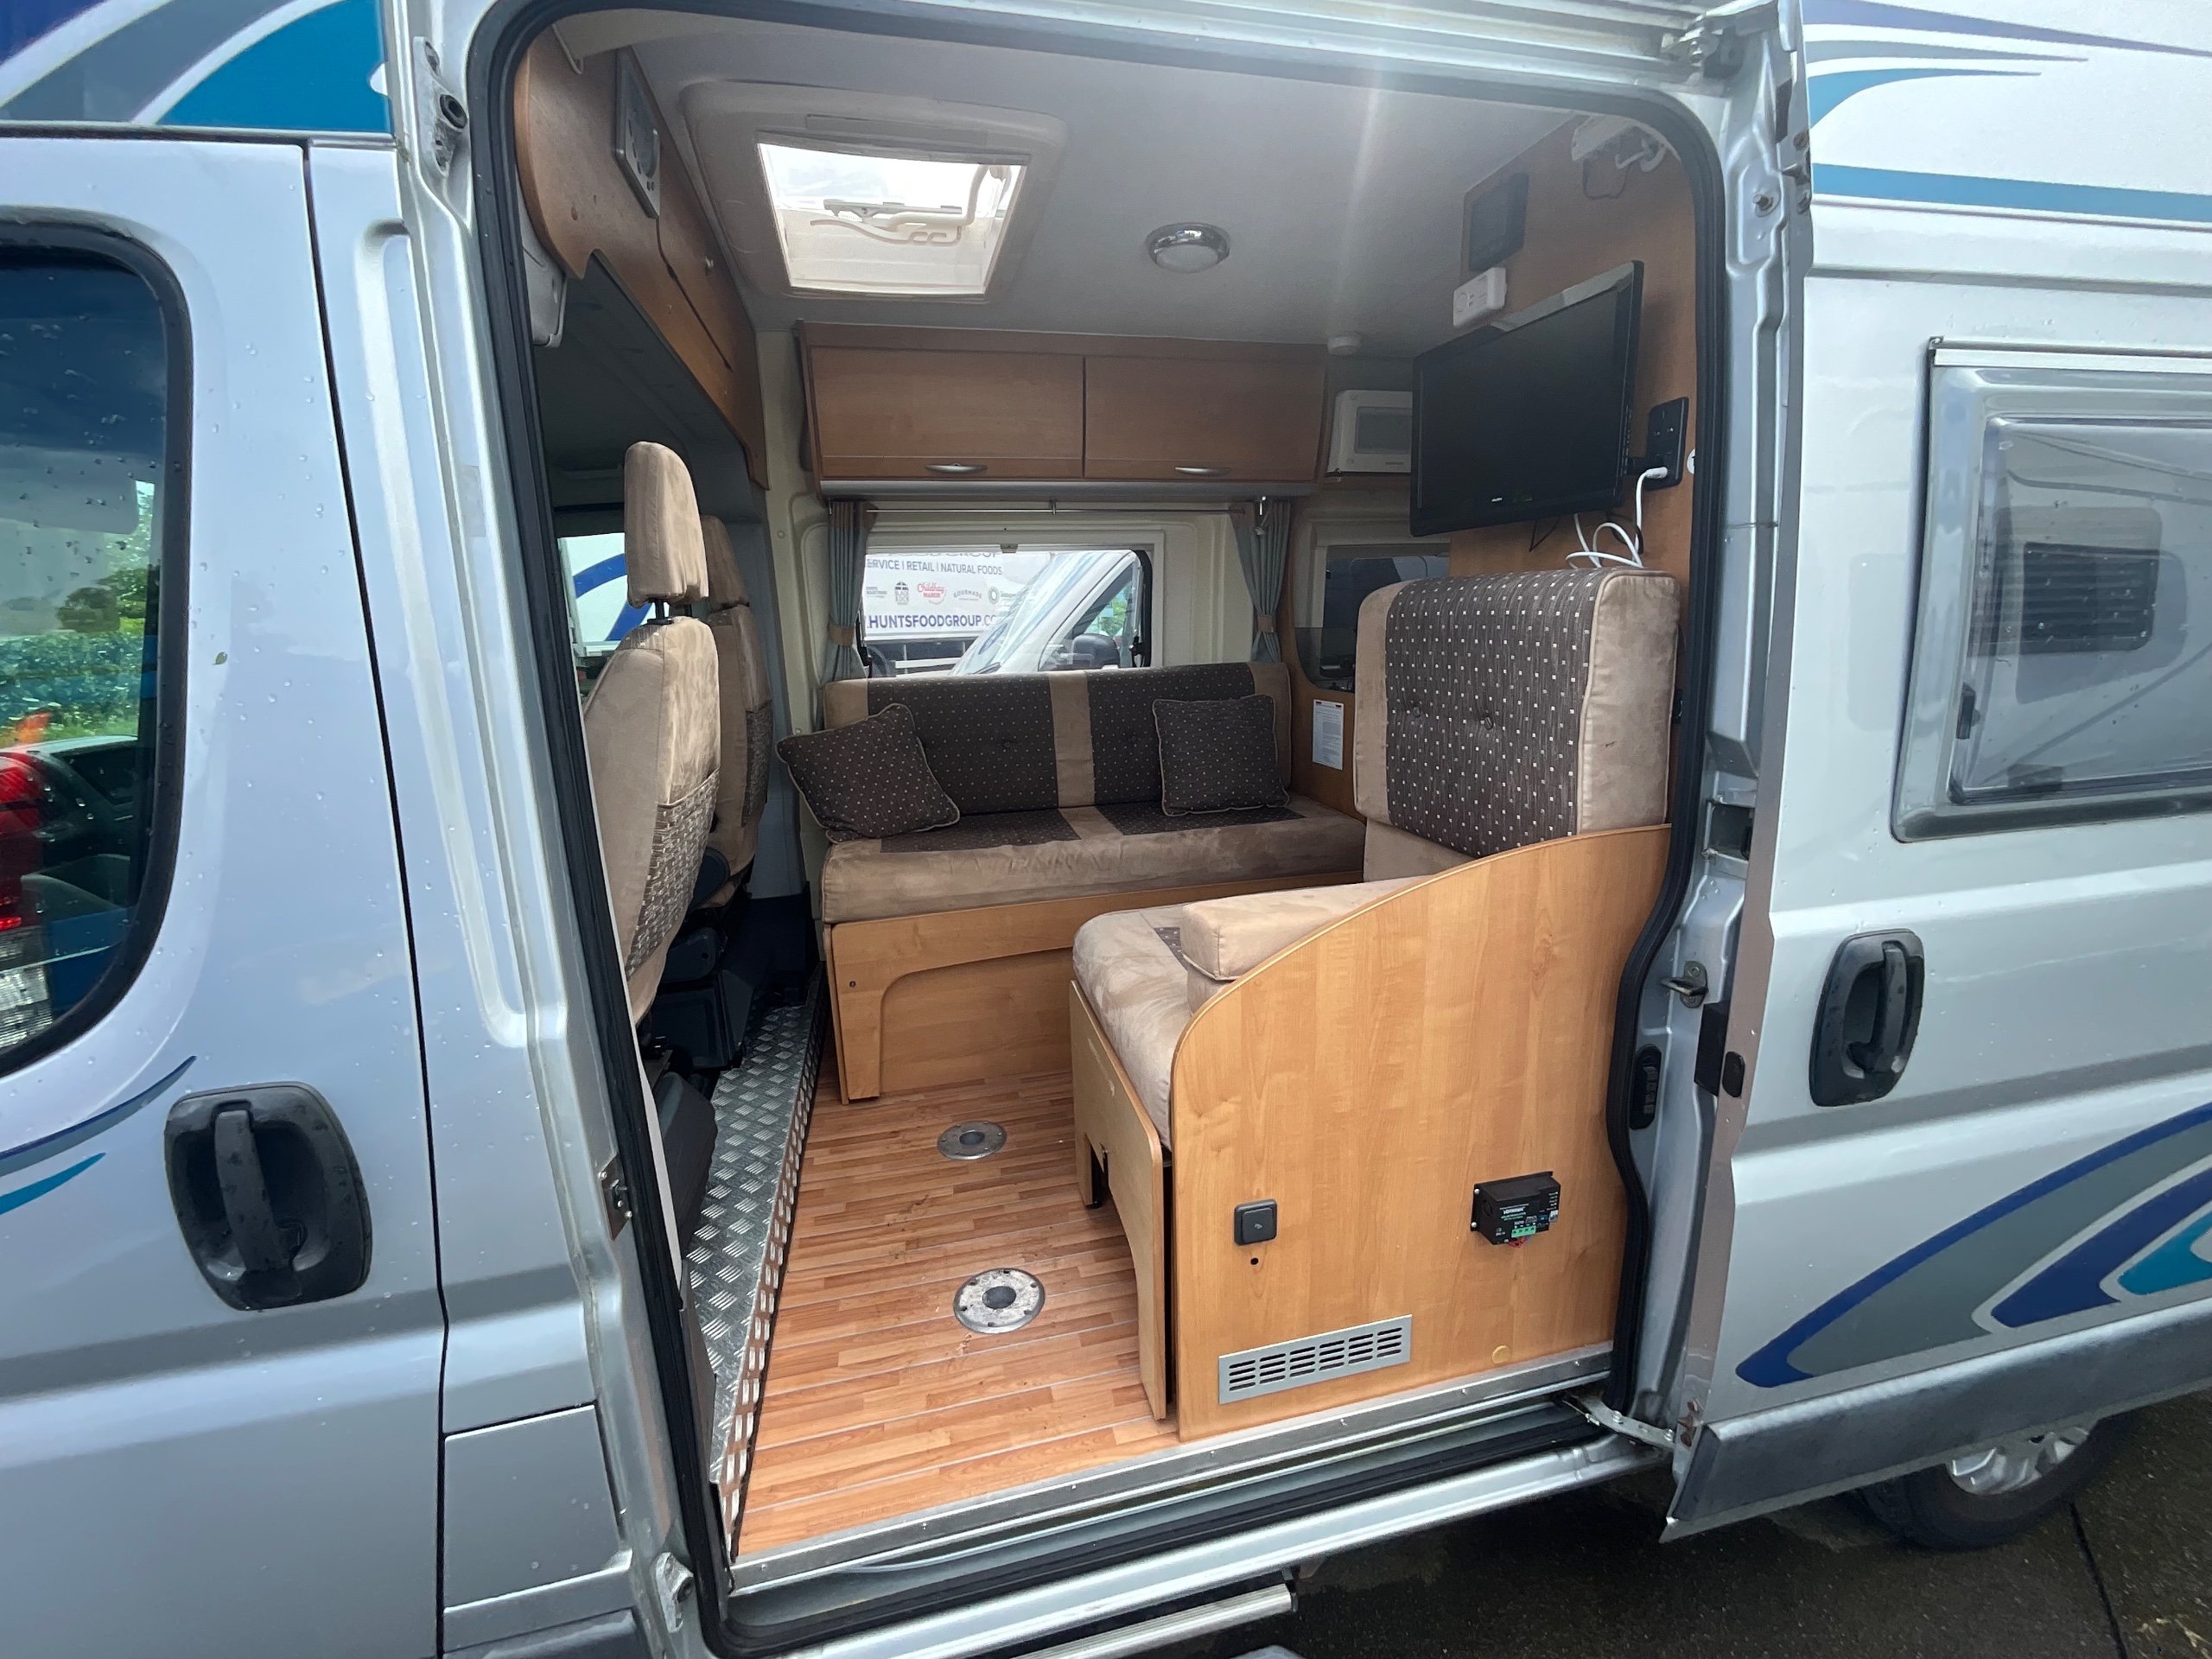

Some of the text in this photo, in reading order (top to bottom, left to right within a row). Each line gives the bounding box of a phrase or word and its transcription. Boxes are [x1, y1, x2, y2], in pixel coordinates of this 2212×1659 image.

[906, 561, 935, 571] RETAIL
[941, 563, 976, 574] NATURAL
[977, 565, 1002, 575] FOODS
